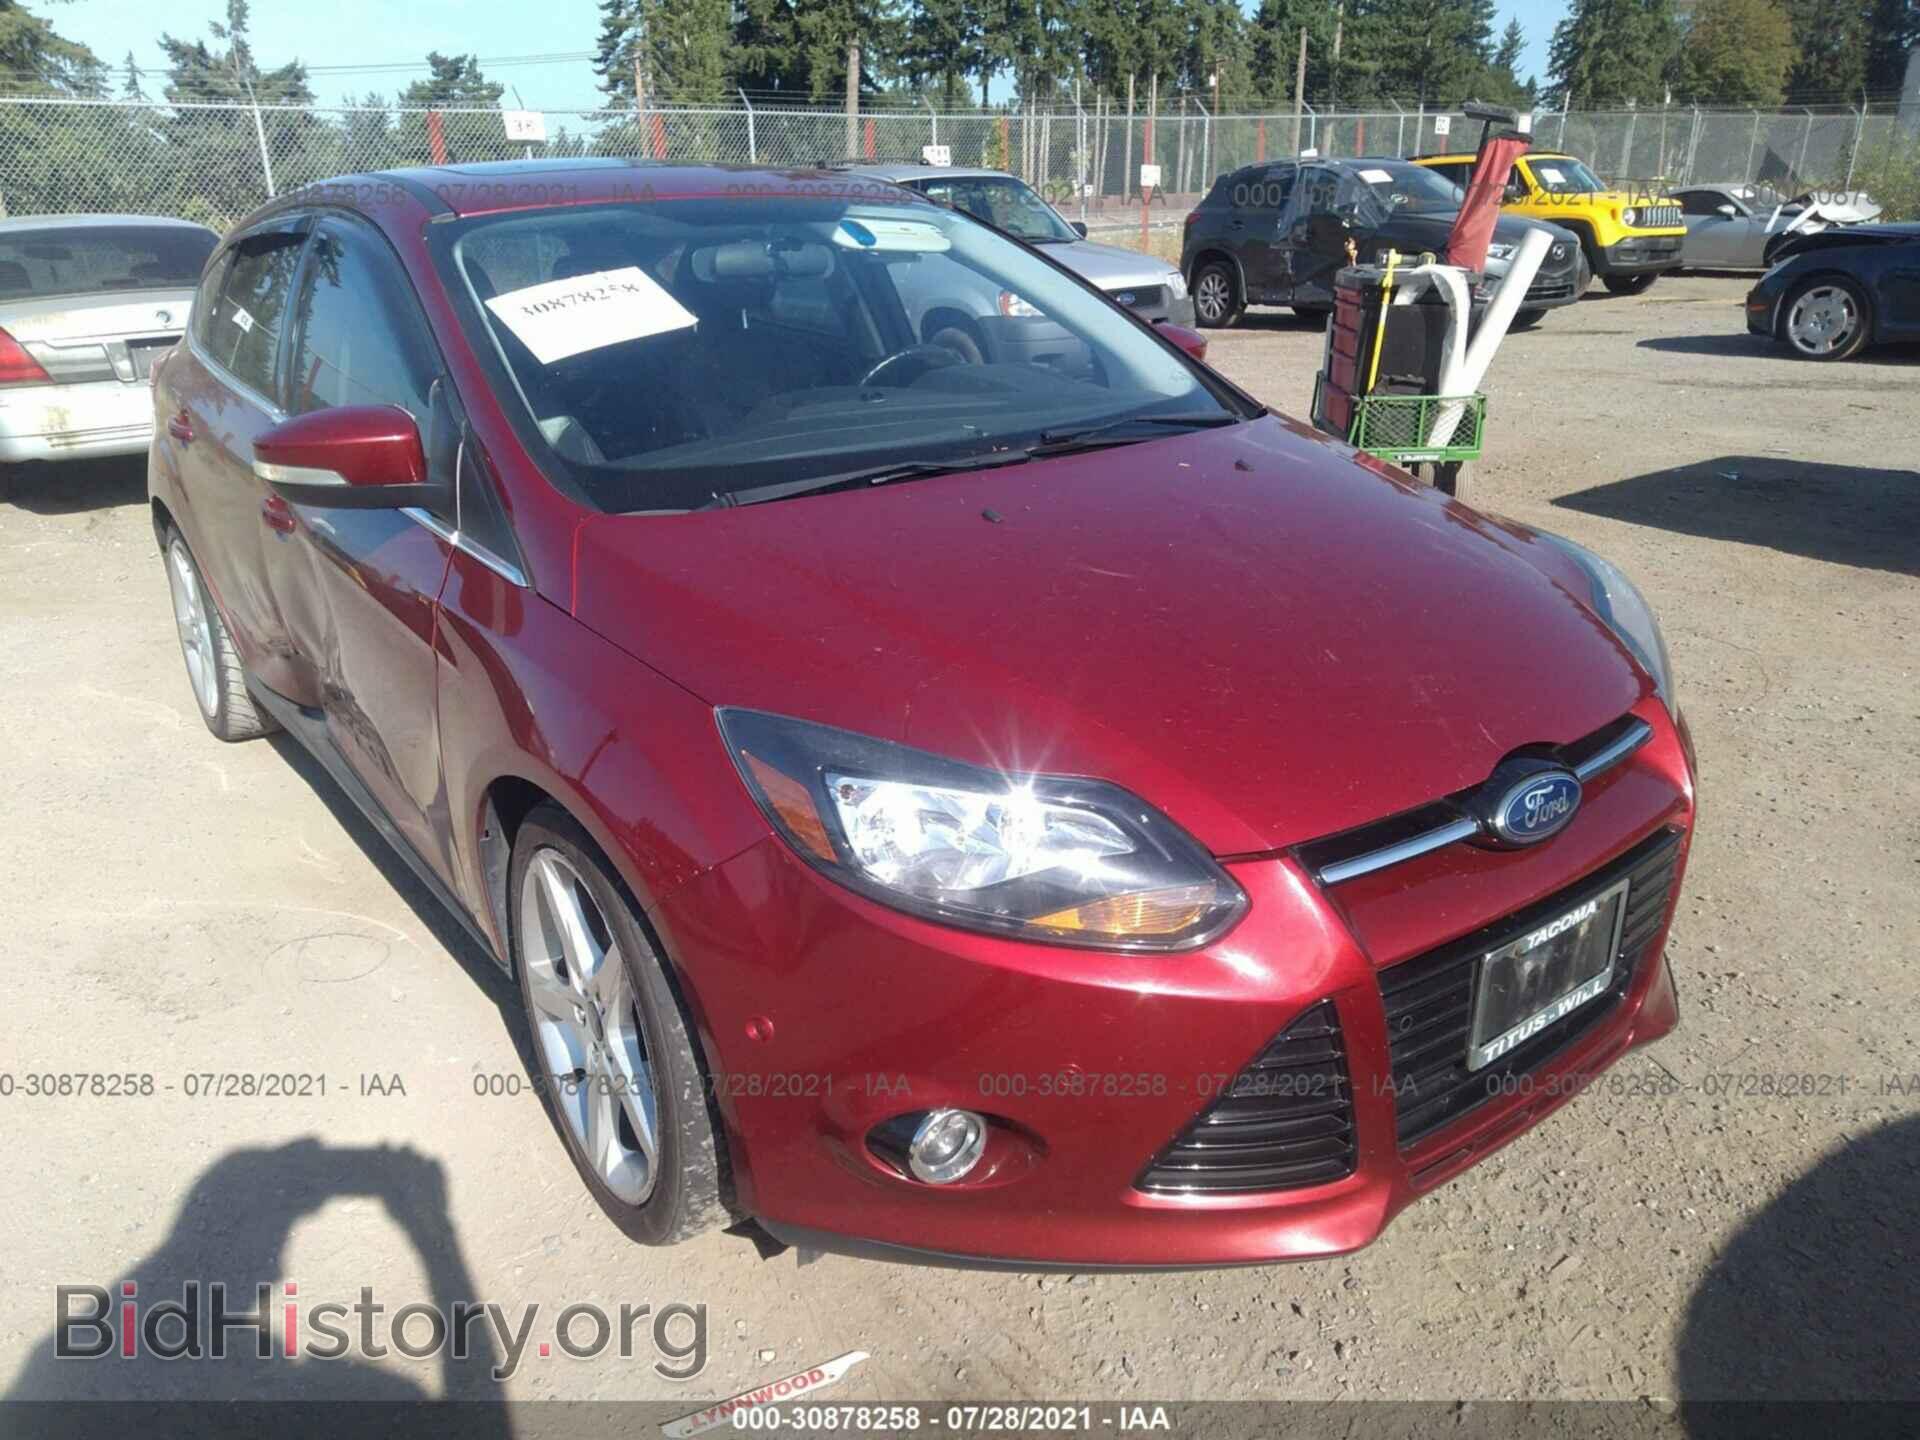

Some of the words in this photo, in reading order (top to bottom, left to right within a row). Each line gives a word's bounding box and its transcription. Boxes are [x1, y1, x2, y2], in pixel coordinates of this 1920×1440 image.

[1524, 784, 1568, 828] Ford
[1526, 900, 1598, 950] TACOMA
[691, 1368, 825, 1427] LYNNWOOD
